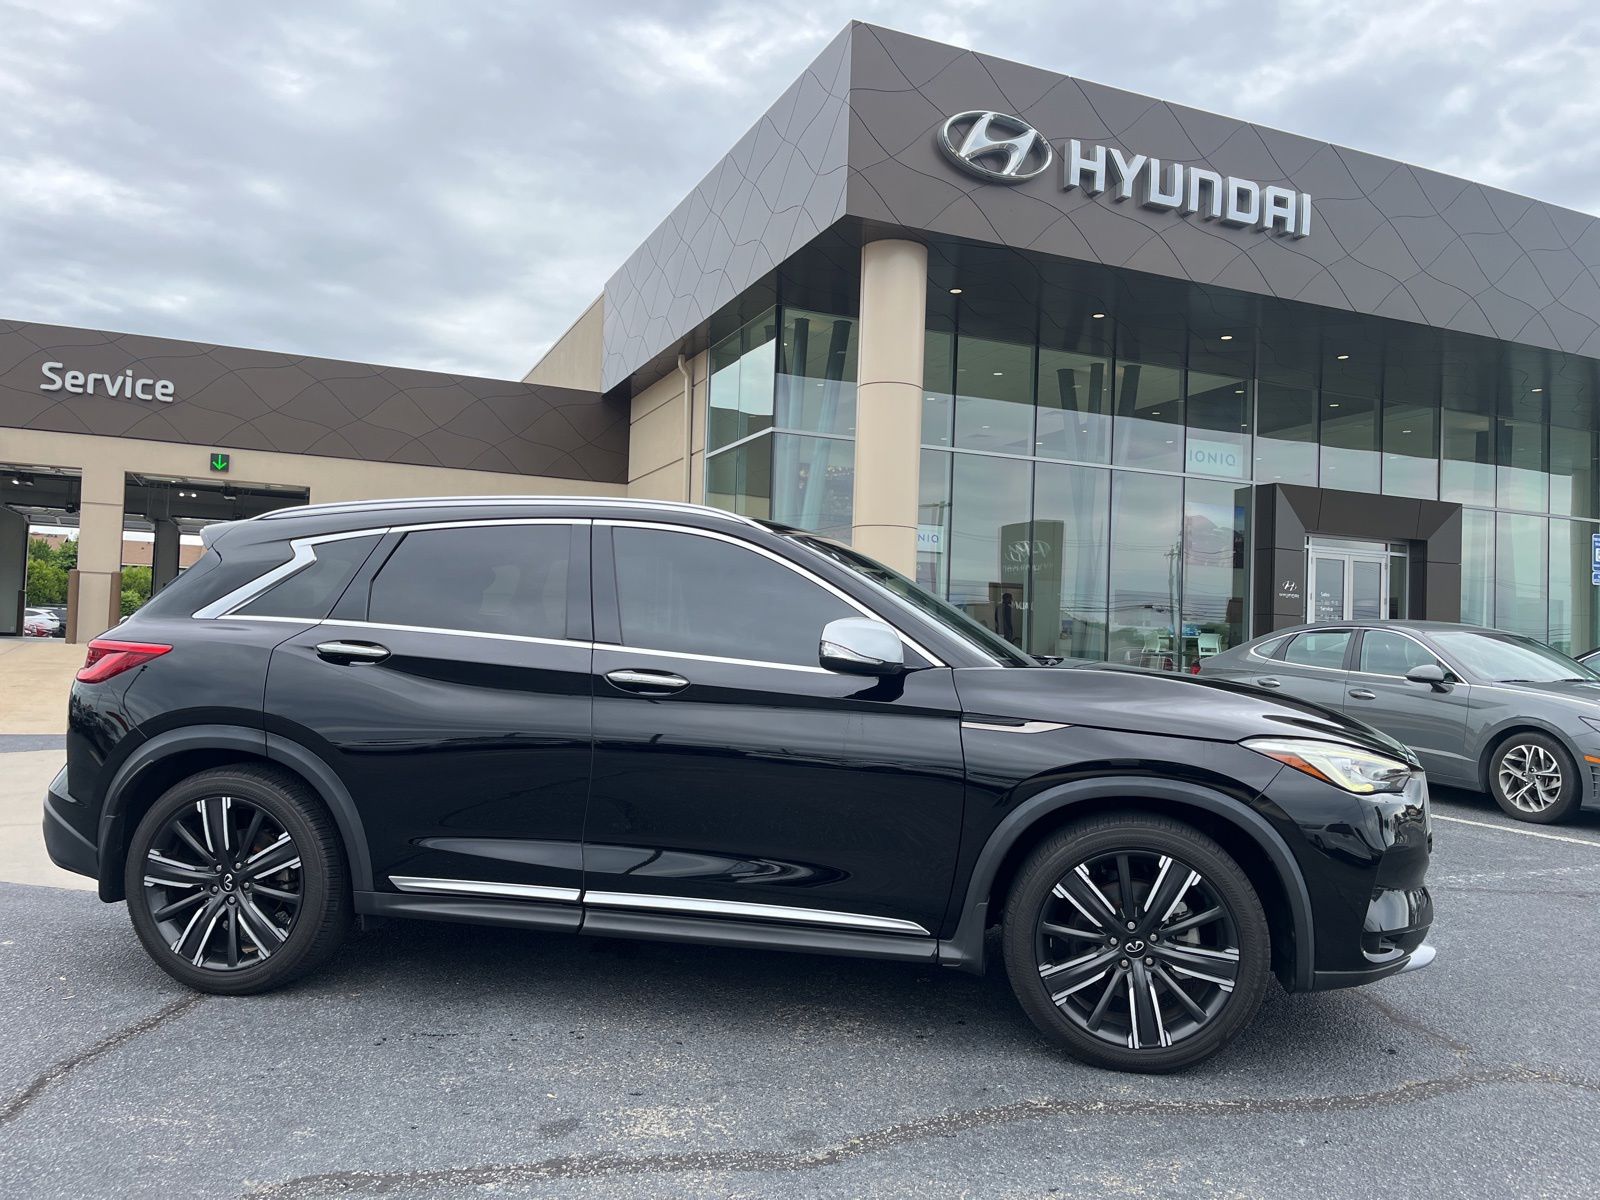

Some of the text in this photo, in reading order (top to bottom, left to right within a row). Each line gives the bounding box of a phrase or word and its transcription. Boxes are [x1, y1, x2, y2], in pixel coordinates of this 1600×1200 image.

[1063, 139, 1312, 239] HYUNDAI
[39, 361, 175, 402] Service
[1189, 448, 1236, 466] IONIQ
[917, 534, 939, 544] NIQ
